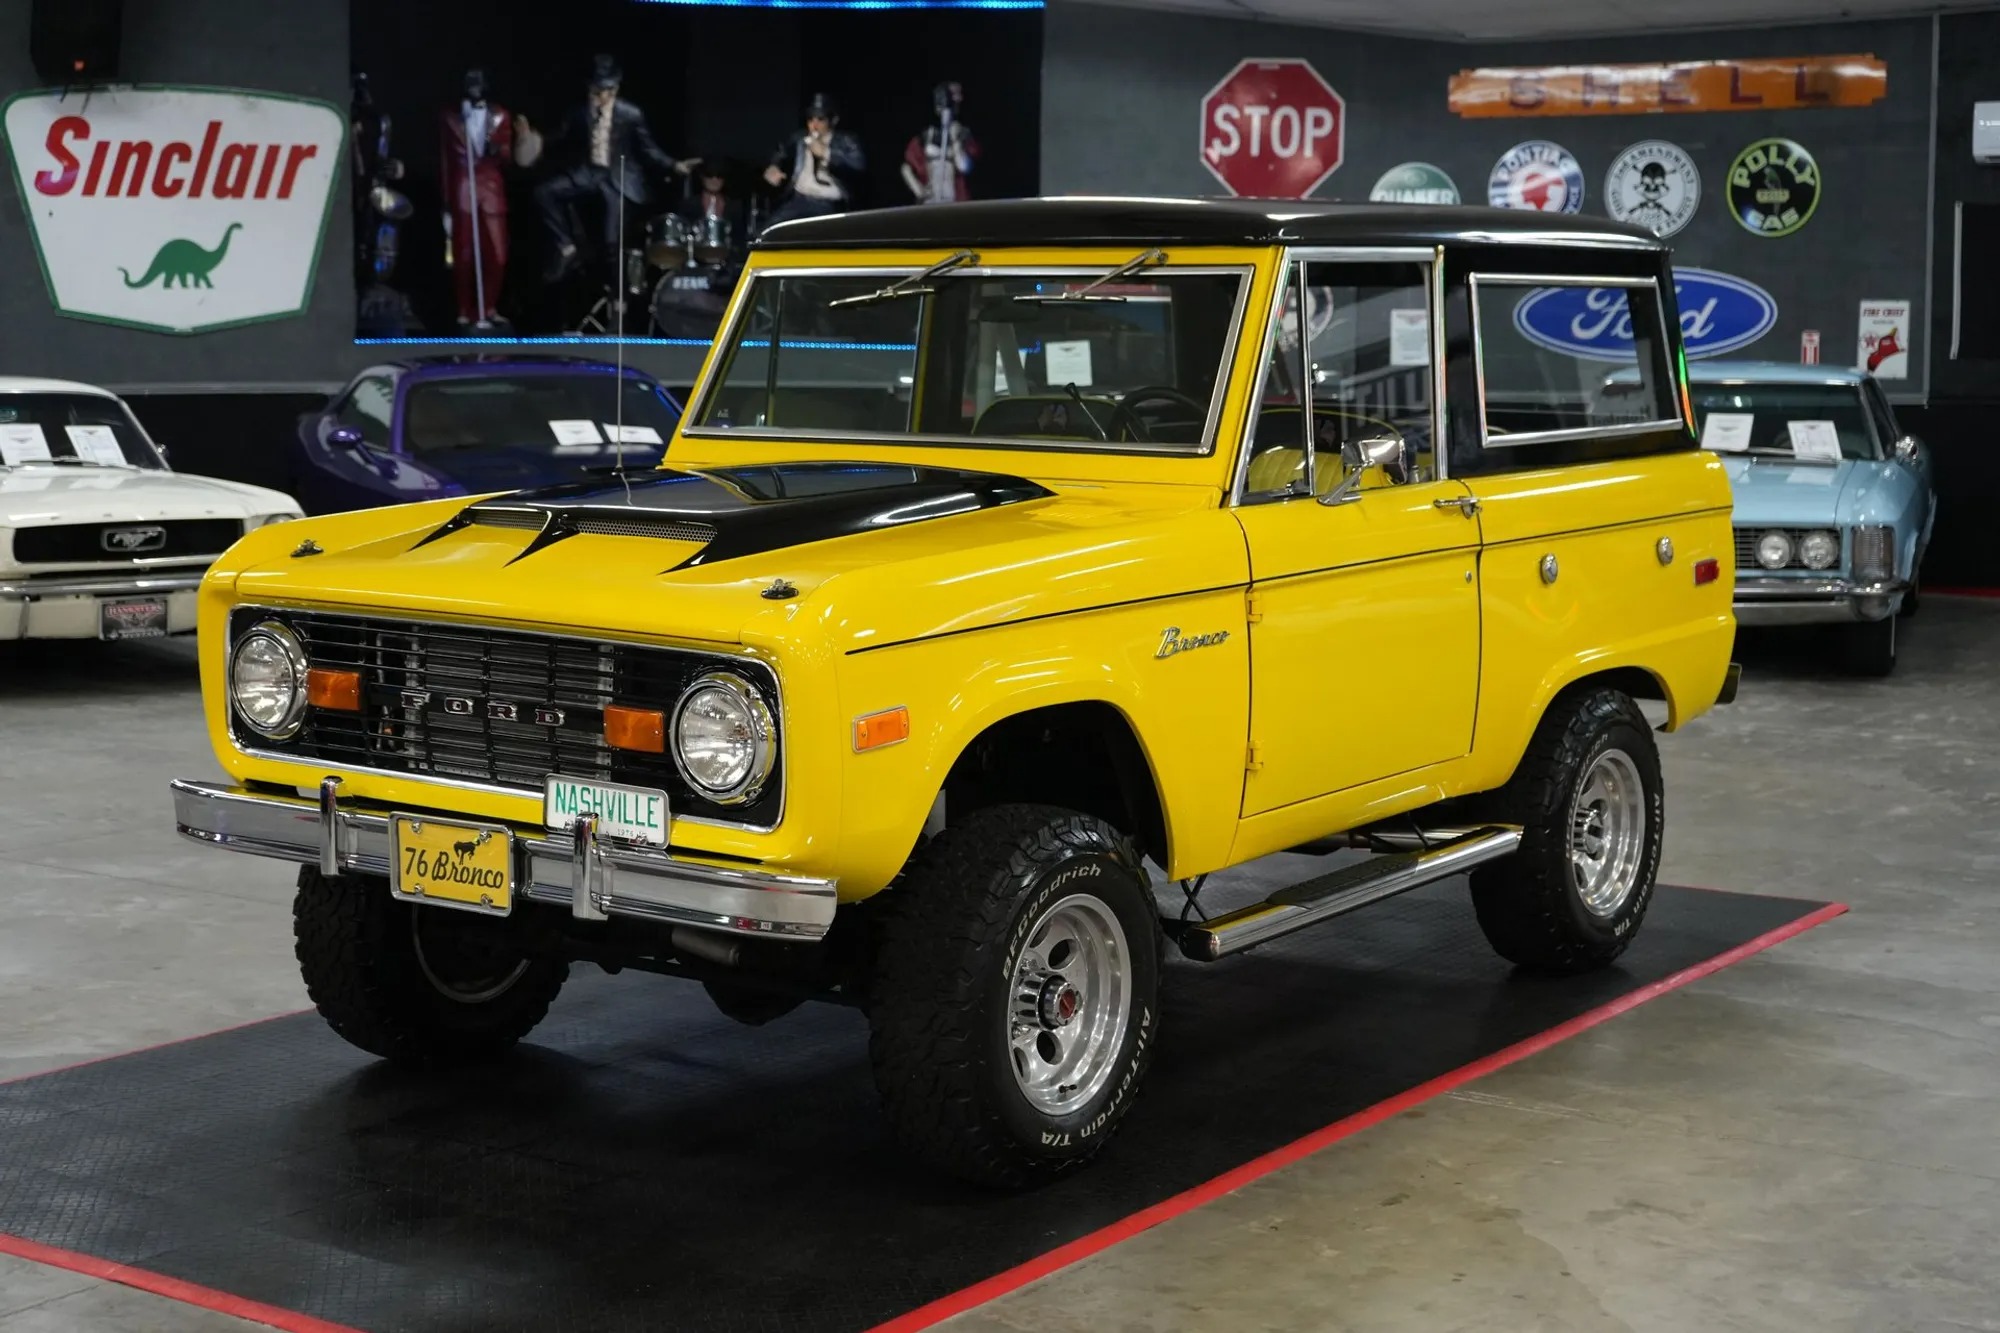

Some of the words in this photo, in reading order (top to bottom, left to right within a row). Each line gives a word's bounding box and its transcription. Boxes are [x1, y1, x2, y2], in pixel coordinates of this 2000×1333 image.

[1508, 63, 1831, 112] SHELL
[1212, 103, 1335, 159] STOP
[34, 115, 318, 199] Sinclair
[1496, 144, 1579, 182] PONTIAC
[1733, 144, 1816, 189] POLLY
[1746, 207, 1800, 231] GAS
[1572, 287, 1719, 340] Fod
[1154, 626, 1230, 659] Bronco
[401, 691, 566, 725] FORD
[554, 782, 660, 830] NASHVILLE
[405, 847, 429, 878] 76
[431, 850, 504, 889] Bronco
[1633, 792, 1661, 916] All-Terrain
[1002, 863, 1103, 981] BFGoodrich
[1614, 917, 1632, 937] T/A
[1080, 1005, 1153, 1139] All-Terrain
[1041, 1131, 1072, 1148] T/A
